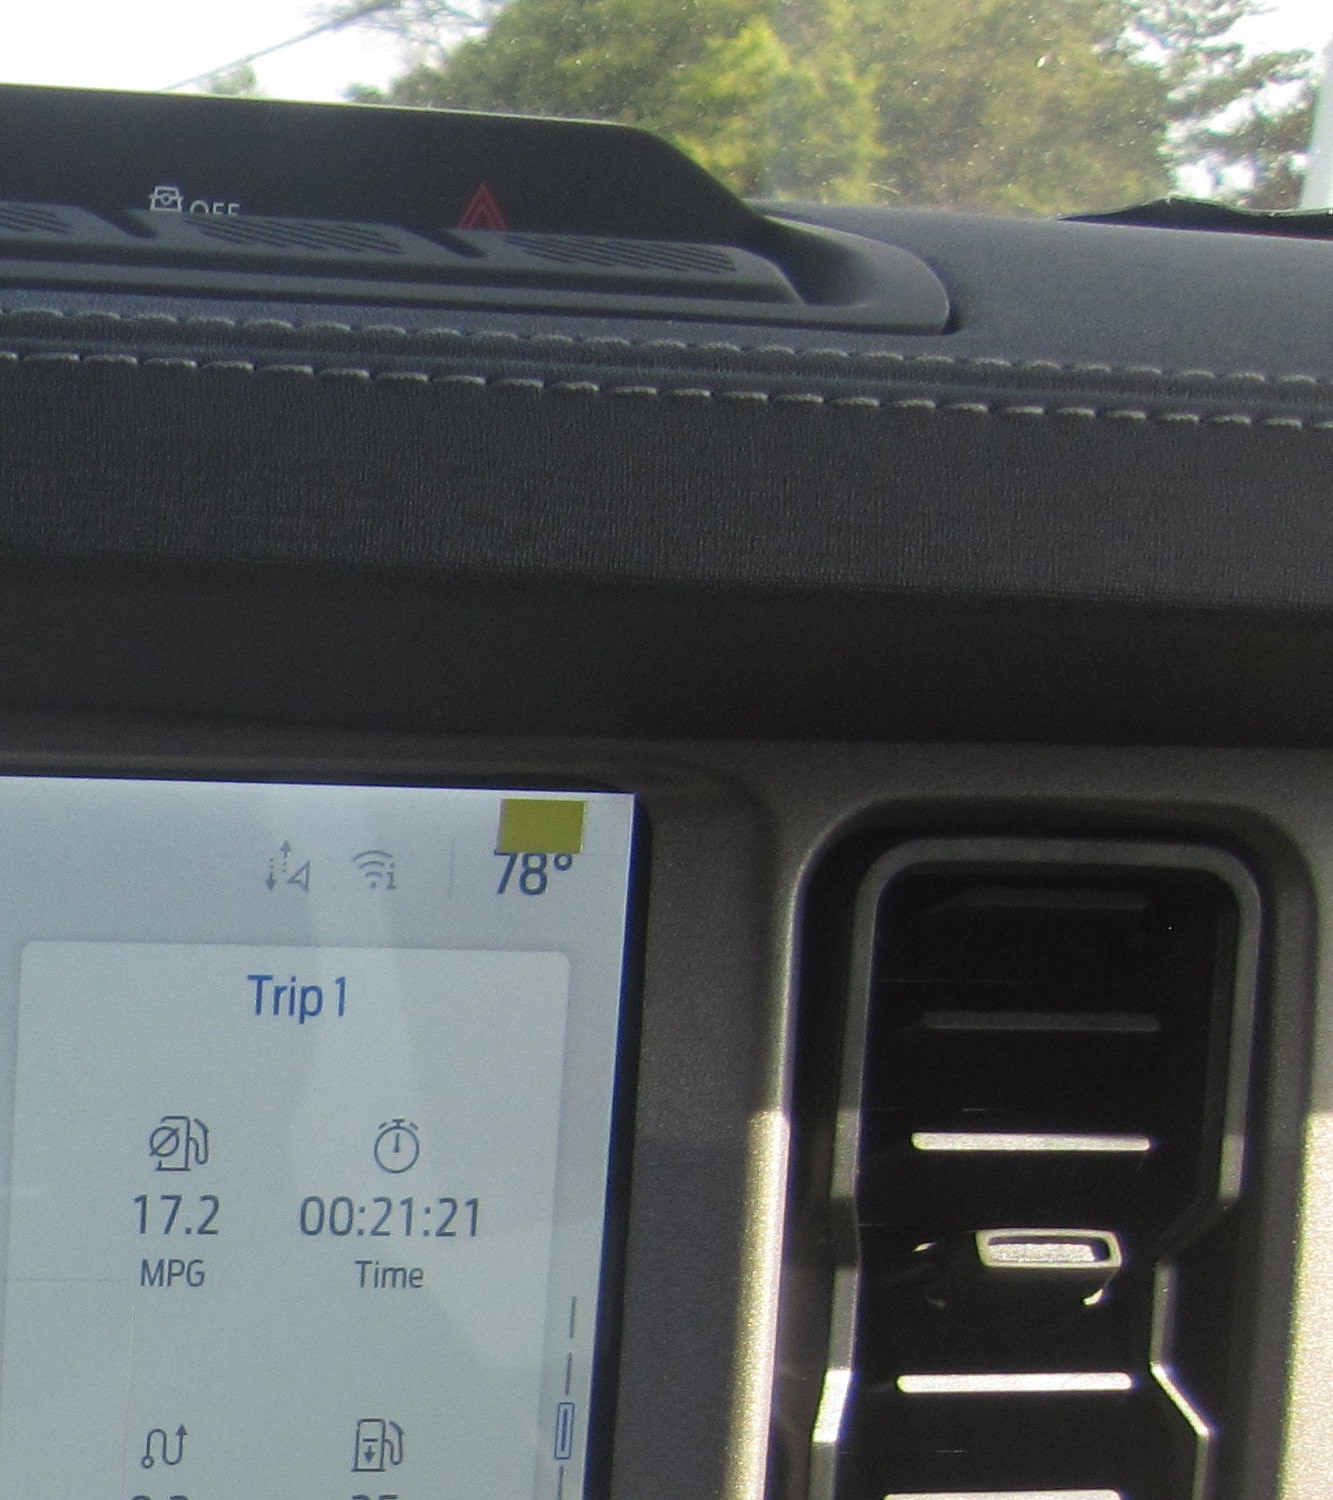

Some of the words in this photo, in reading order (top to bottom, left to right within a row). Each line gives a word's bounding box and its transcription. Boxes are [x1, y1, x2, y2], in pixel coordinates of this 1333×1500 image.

[247, 974, 324, 1025] Trip
[333, 976, 348, 1018] 1
[132, 1194, 221, 1236] 17.2
[299, 1195, 481, 1238] 00:21:21
[140, 1257, 207, 1289] MPG
[354, 1259, 425, 1290] Time
